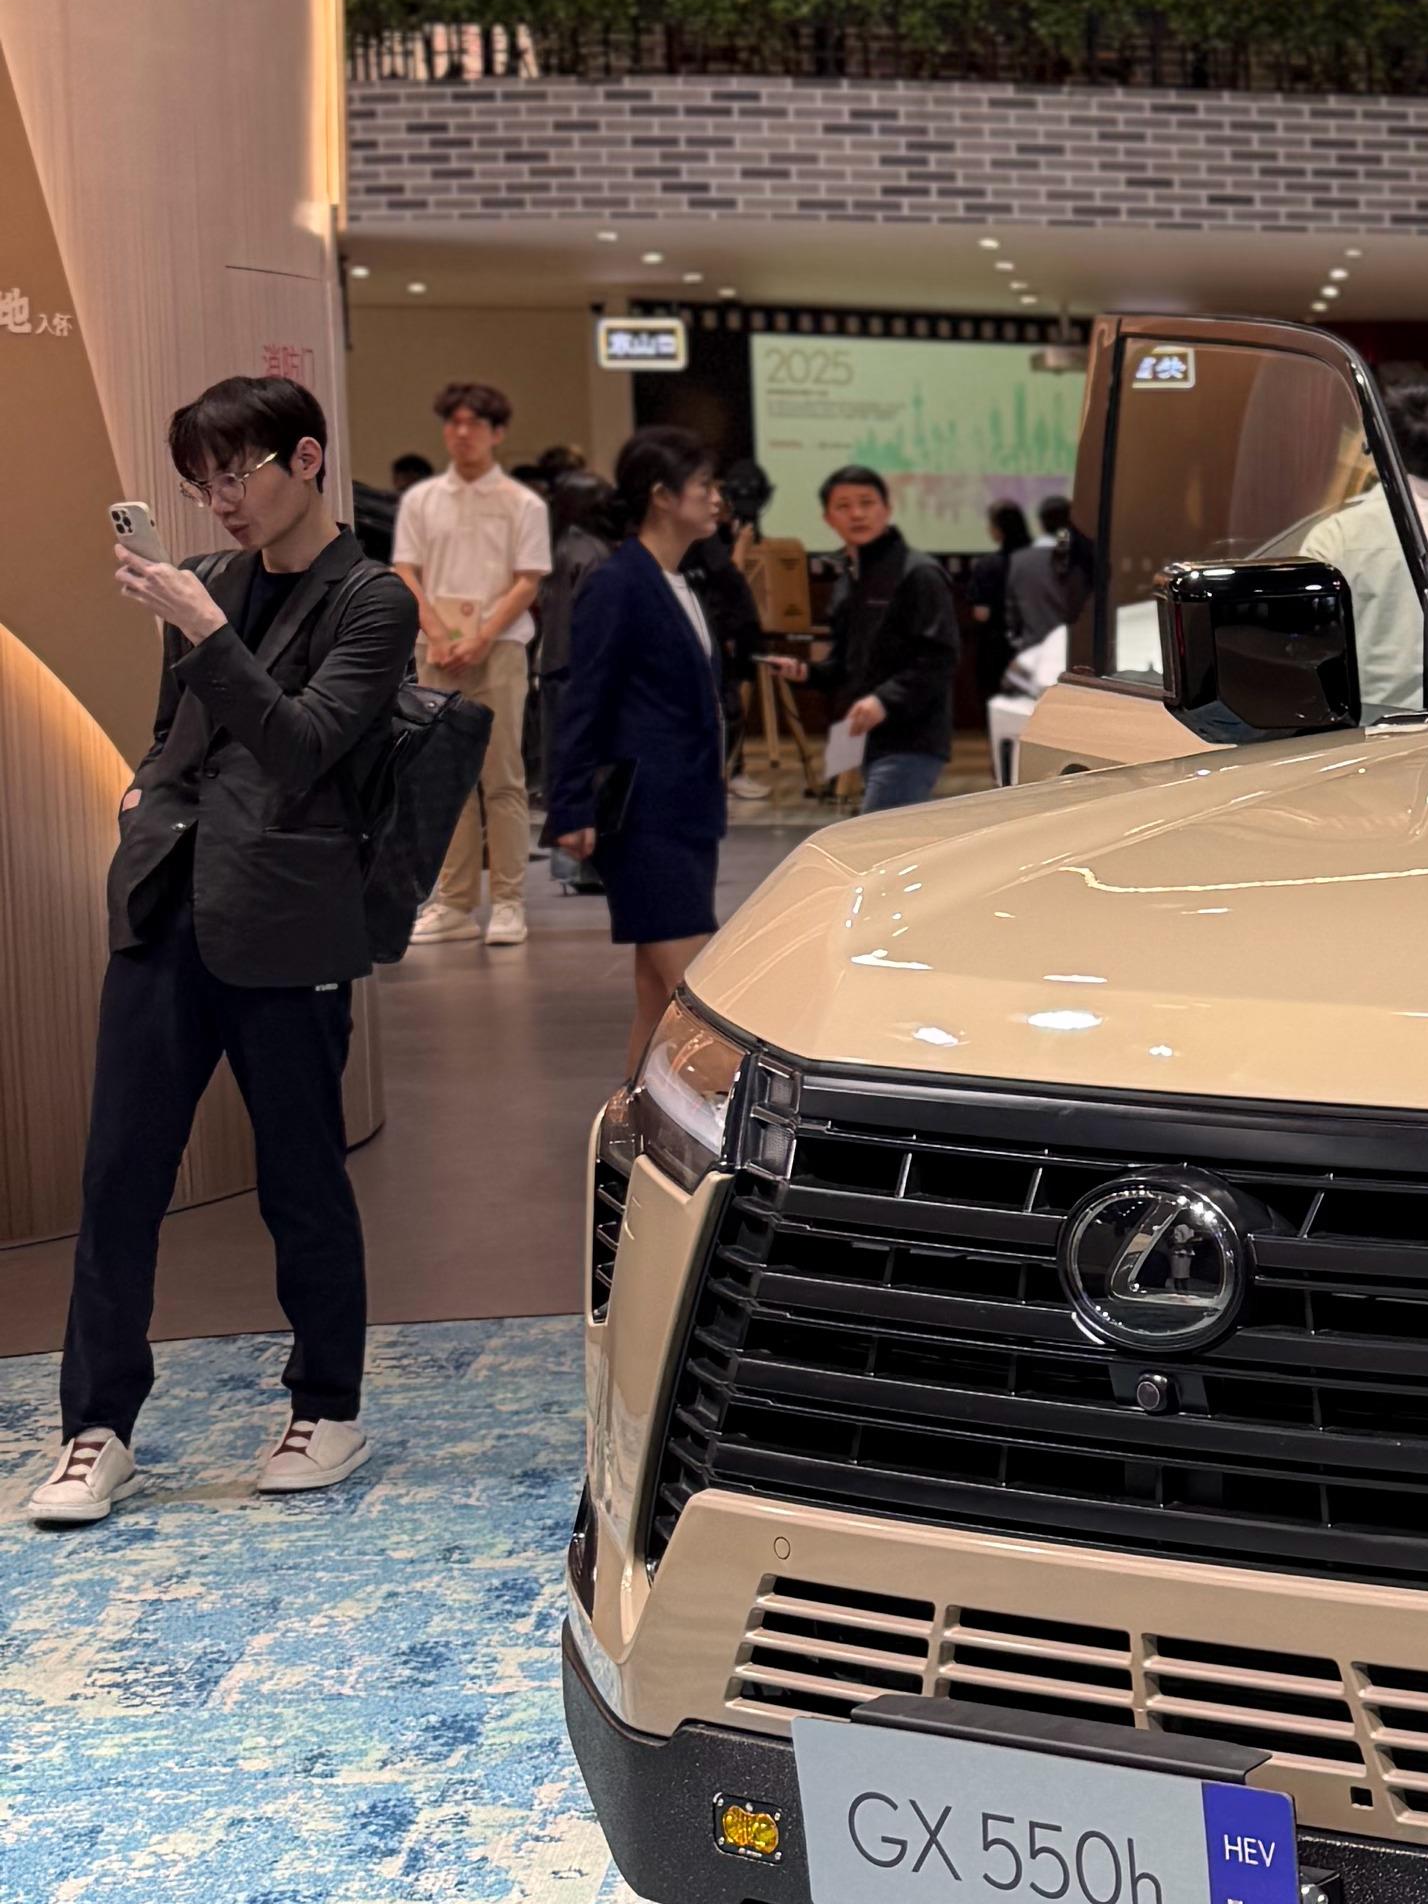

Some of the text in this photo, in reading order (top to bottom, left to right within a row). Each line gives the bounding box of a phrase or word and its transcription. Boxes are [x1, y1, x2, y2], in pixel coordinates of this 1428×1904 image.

[765, 347, 854, 386] 2025
[848, 1791, 962, 1881] GX
[1224, 1834, 1276, 1868] HEV
